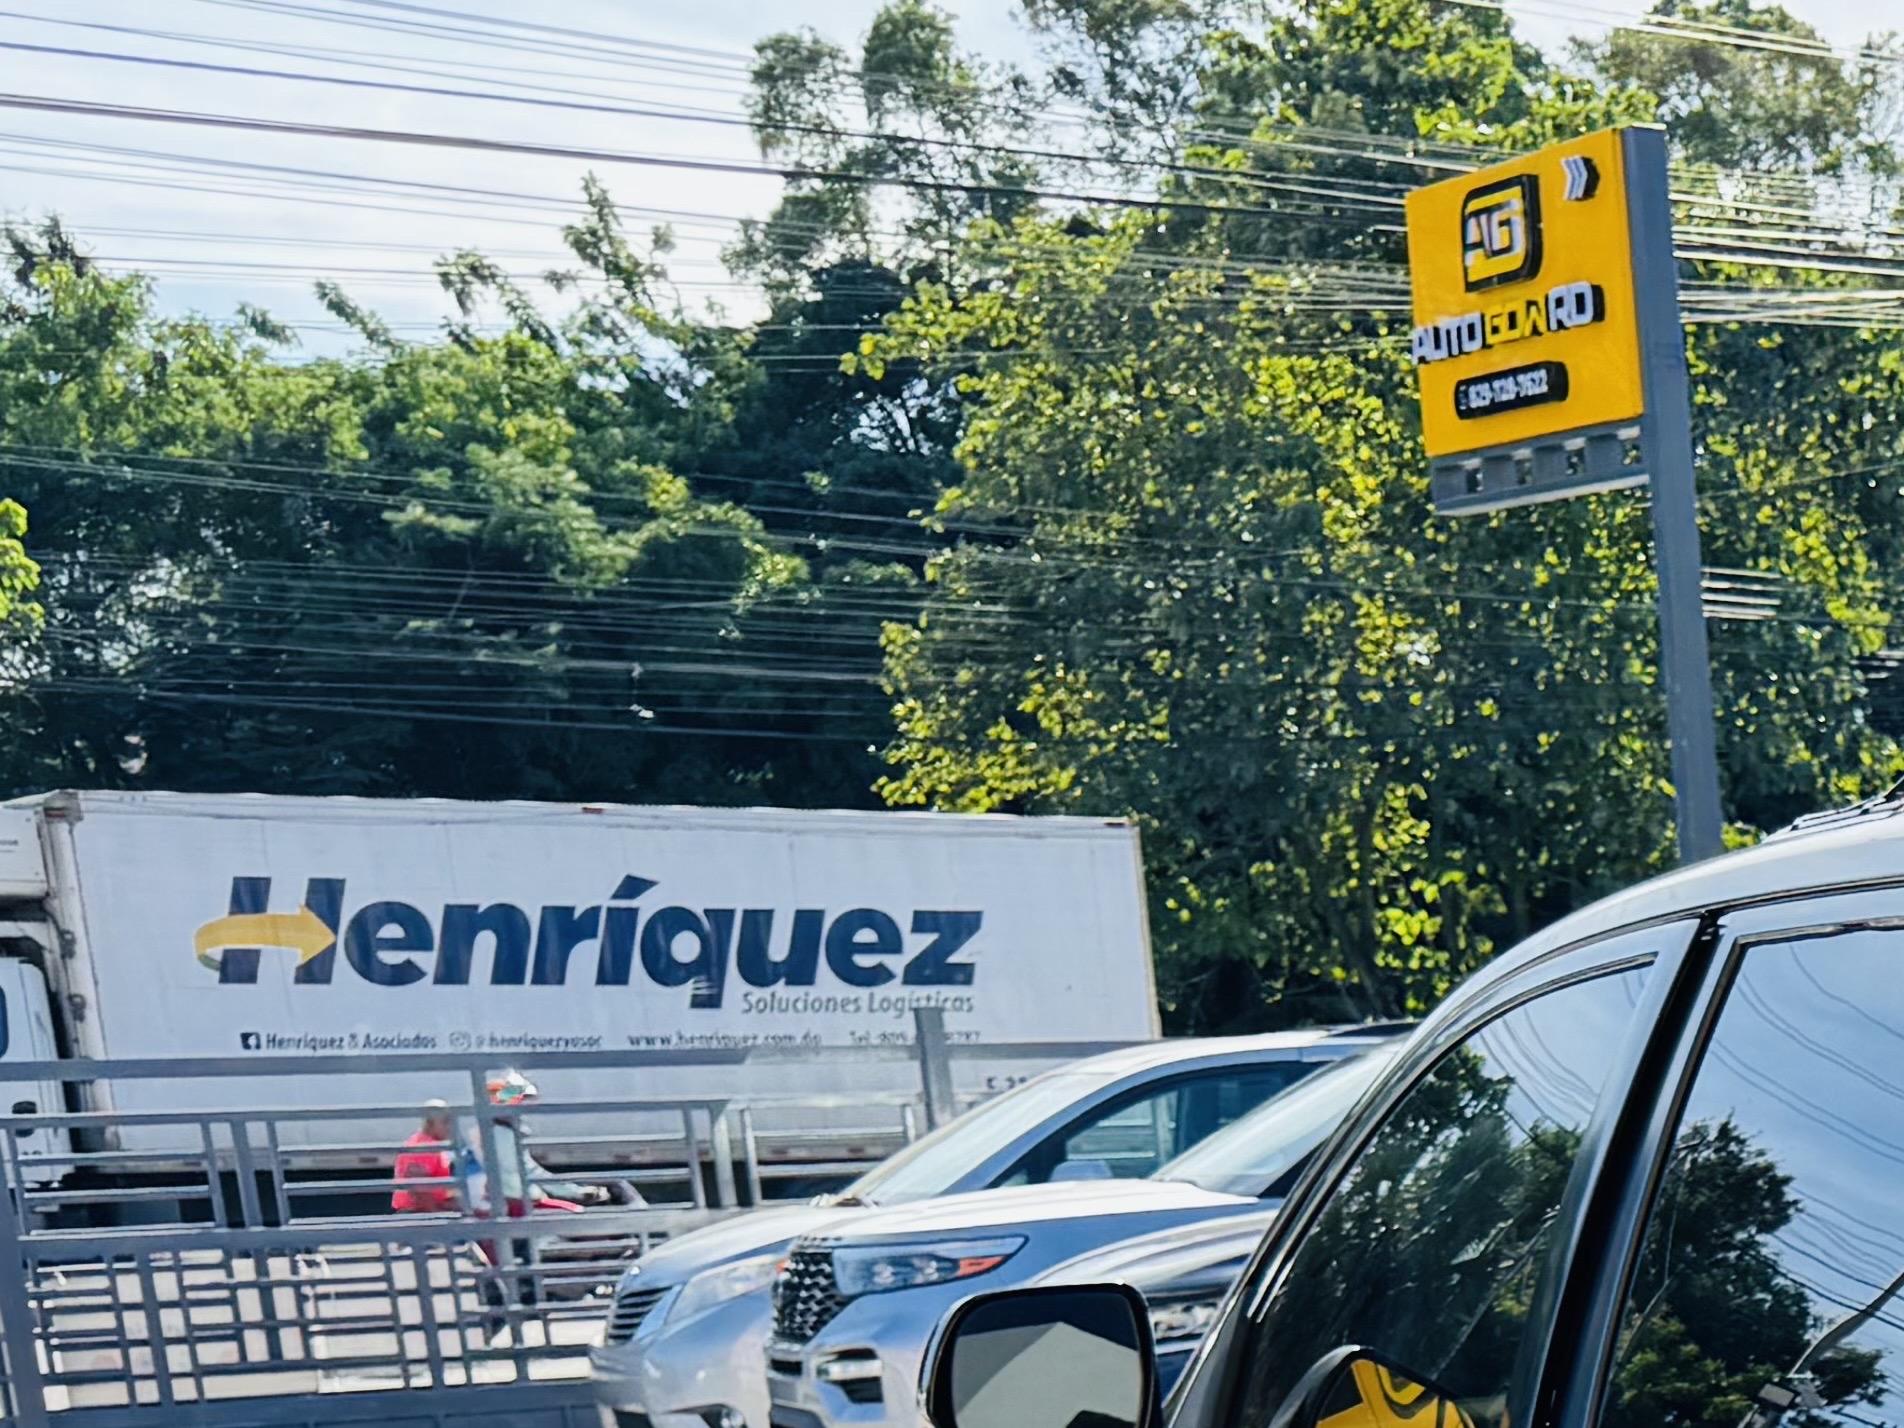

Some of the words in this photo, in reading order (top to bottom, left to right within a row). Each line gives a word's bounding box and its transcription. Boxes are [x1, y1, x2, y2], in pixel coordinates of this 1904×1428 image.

[218, 873, 984, 1009] Henríquez
[741, 990, 861, 1014] Soluciones
[867, 989, 975, 1019] Logísticas
[362, 1031, 437, 1050] Asociados
